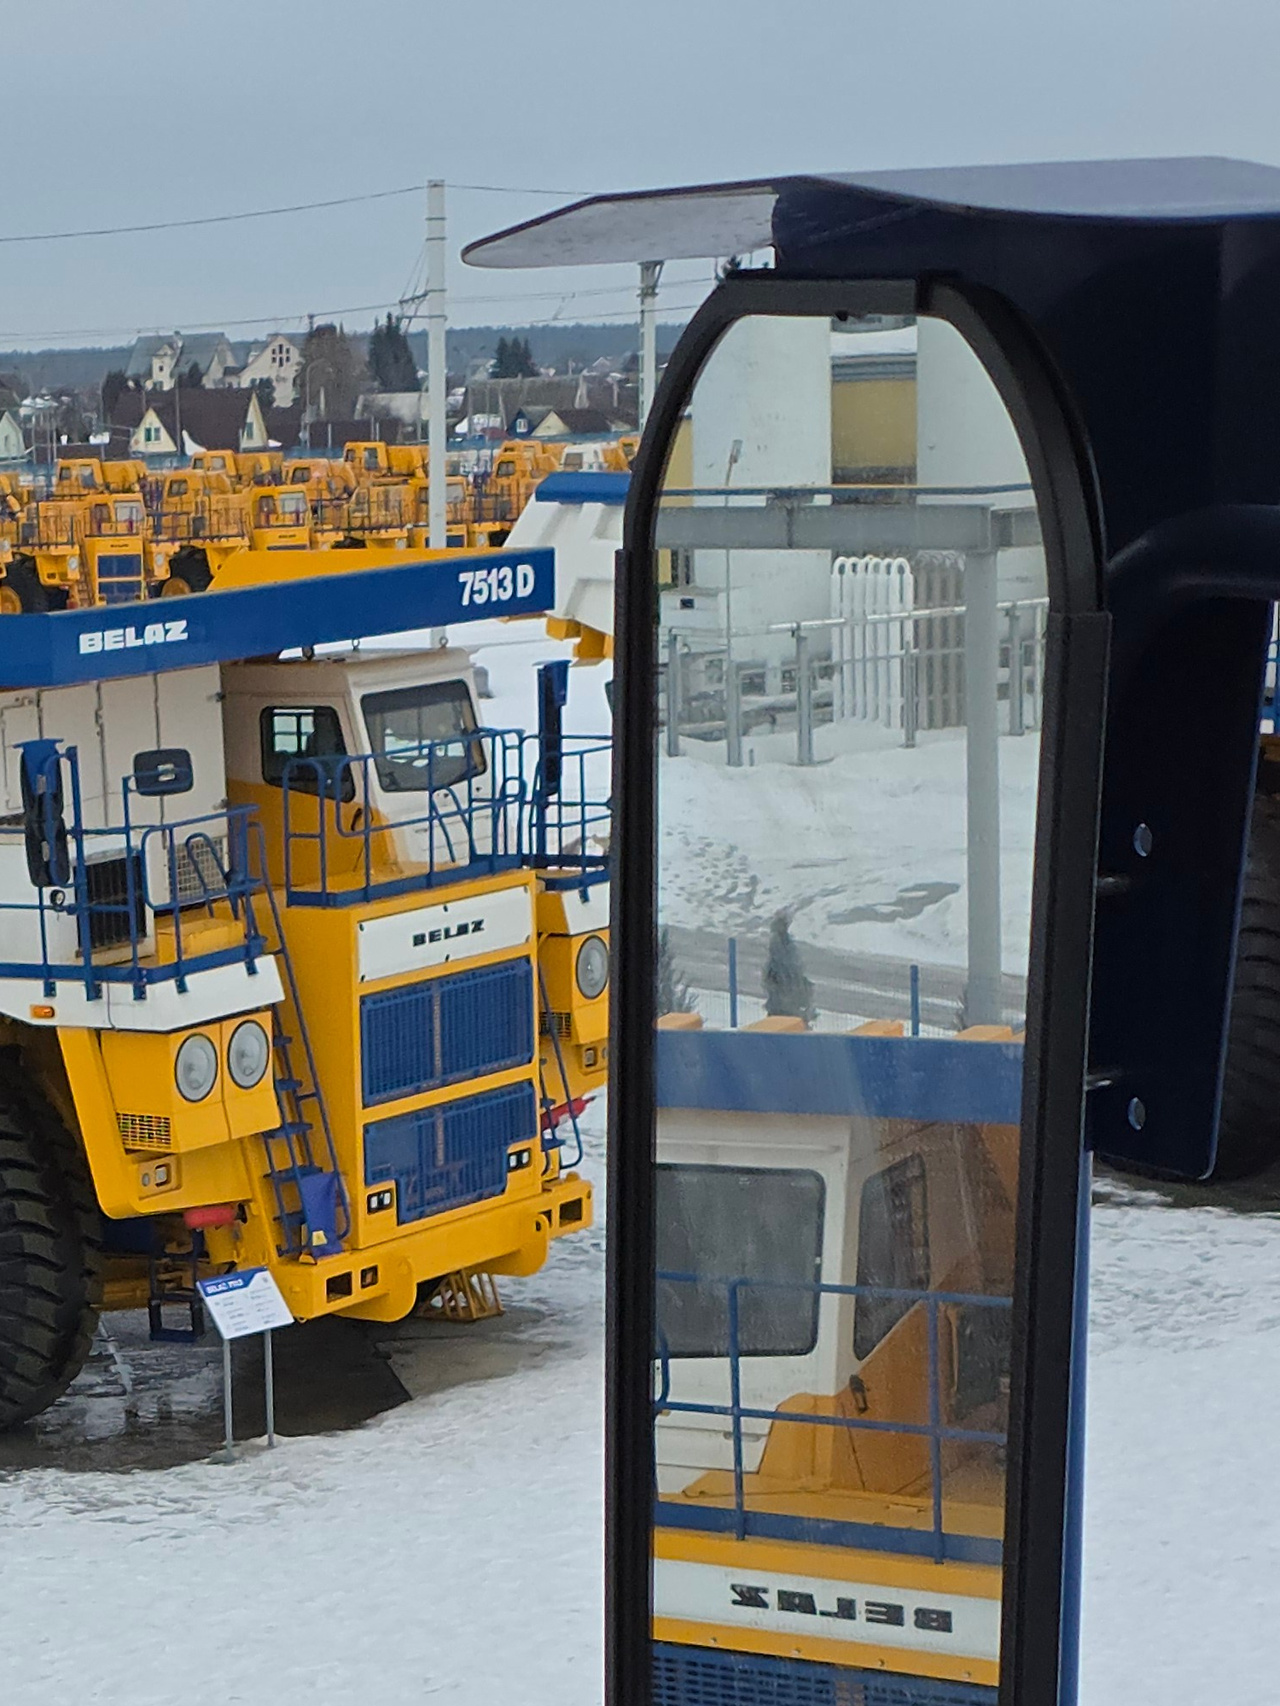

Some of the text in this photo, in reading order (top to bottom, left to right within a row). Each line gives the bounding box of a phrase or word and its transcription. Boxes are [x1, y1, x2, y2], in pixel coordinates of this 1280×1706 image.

[458, 564, 535, 606] 7513 D
[79, 619, 189, 655] BELAZ
[412, 918, 485, 947] BELAZ
